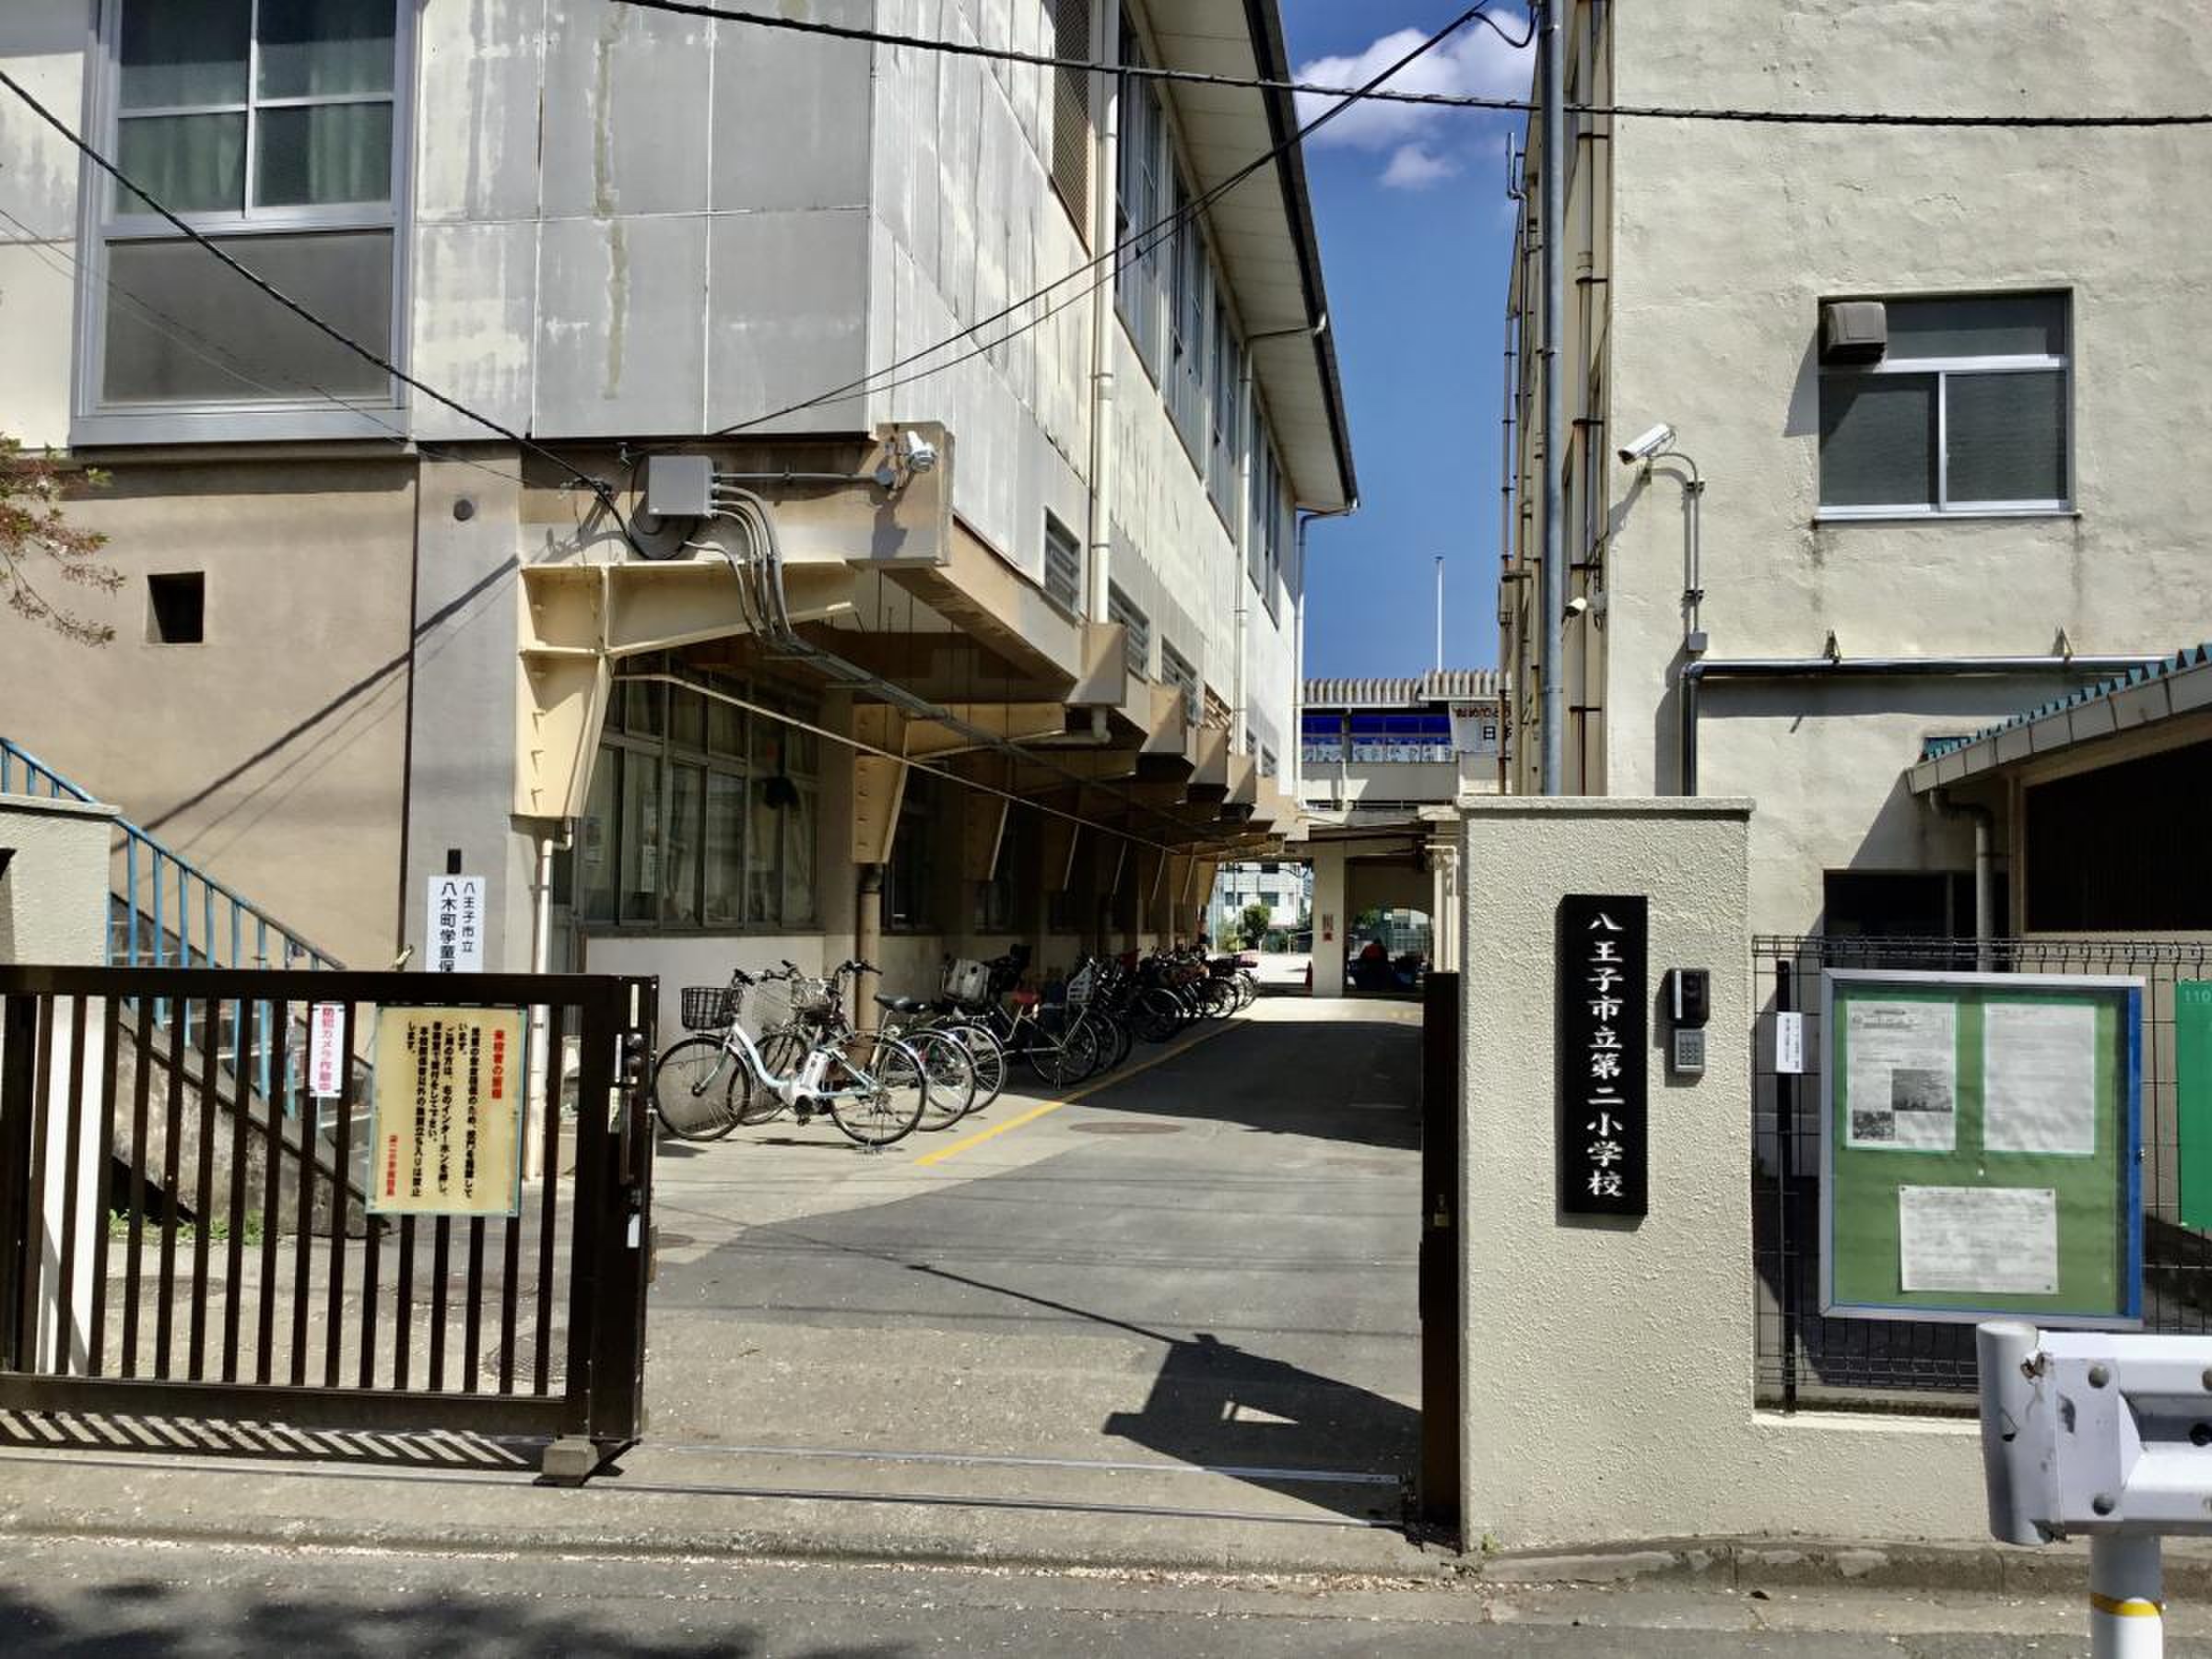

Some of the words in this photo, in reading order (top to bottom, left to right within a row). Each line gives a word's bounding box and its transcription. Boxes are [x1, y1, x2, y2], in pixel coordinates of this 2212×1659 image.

[439, 882, 458, 973] 八木町学童保
[462, 882, 475, 953] 八王子市立
[1587, 912, 1625, 1196] 八王子市立第二小学校
